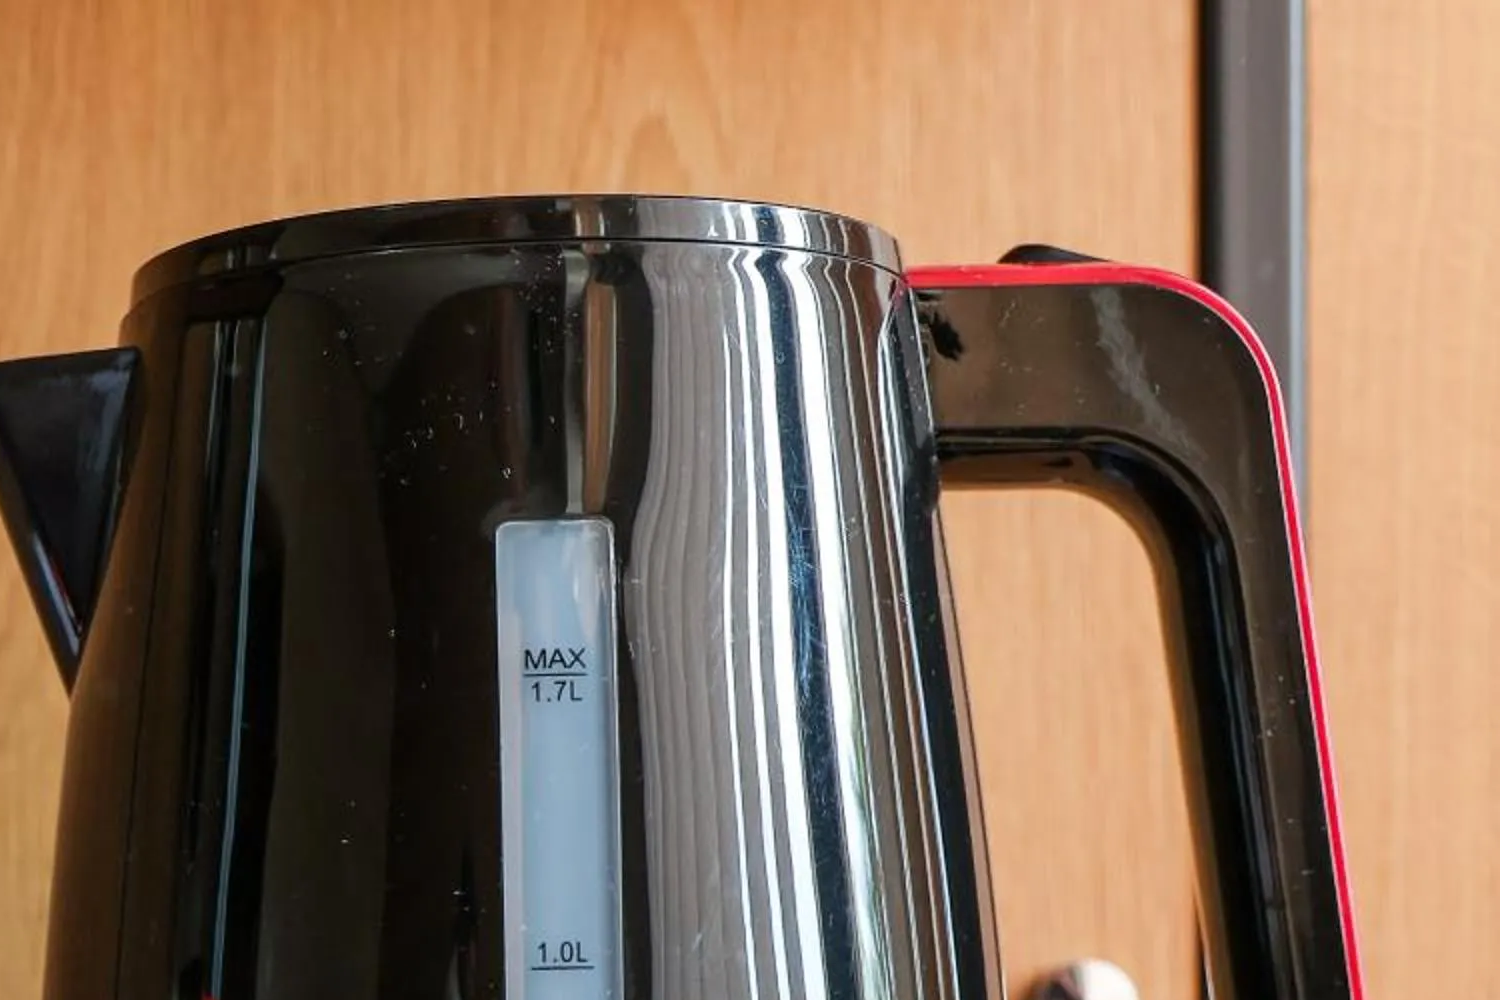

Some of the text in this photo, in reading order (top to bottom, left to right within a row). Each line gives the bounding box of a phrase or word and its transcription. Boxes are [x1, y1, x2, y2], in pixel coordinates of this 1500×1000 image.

[524, 648, 586, 670] MAX
[531, 681, 583, 703] 1.7L
[537, 941, 589, 964] 1.0L
